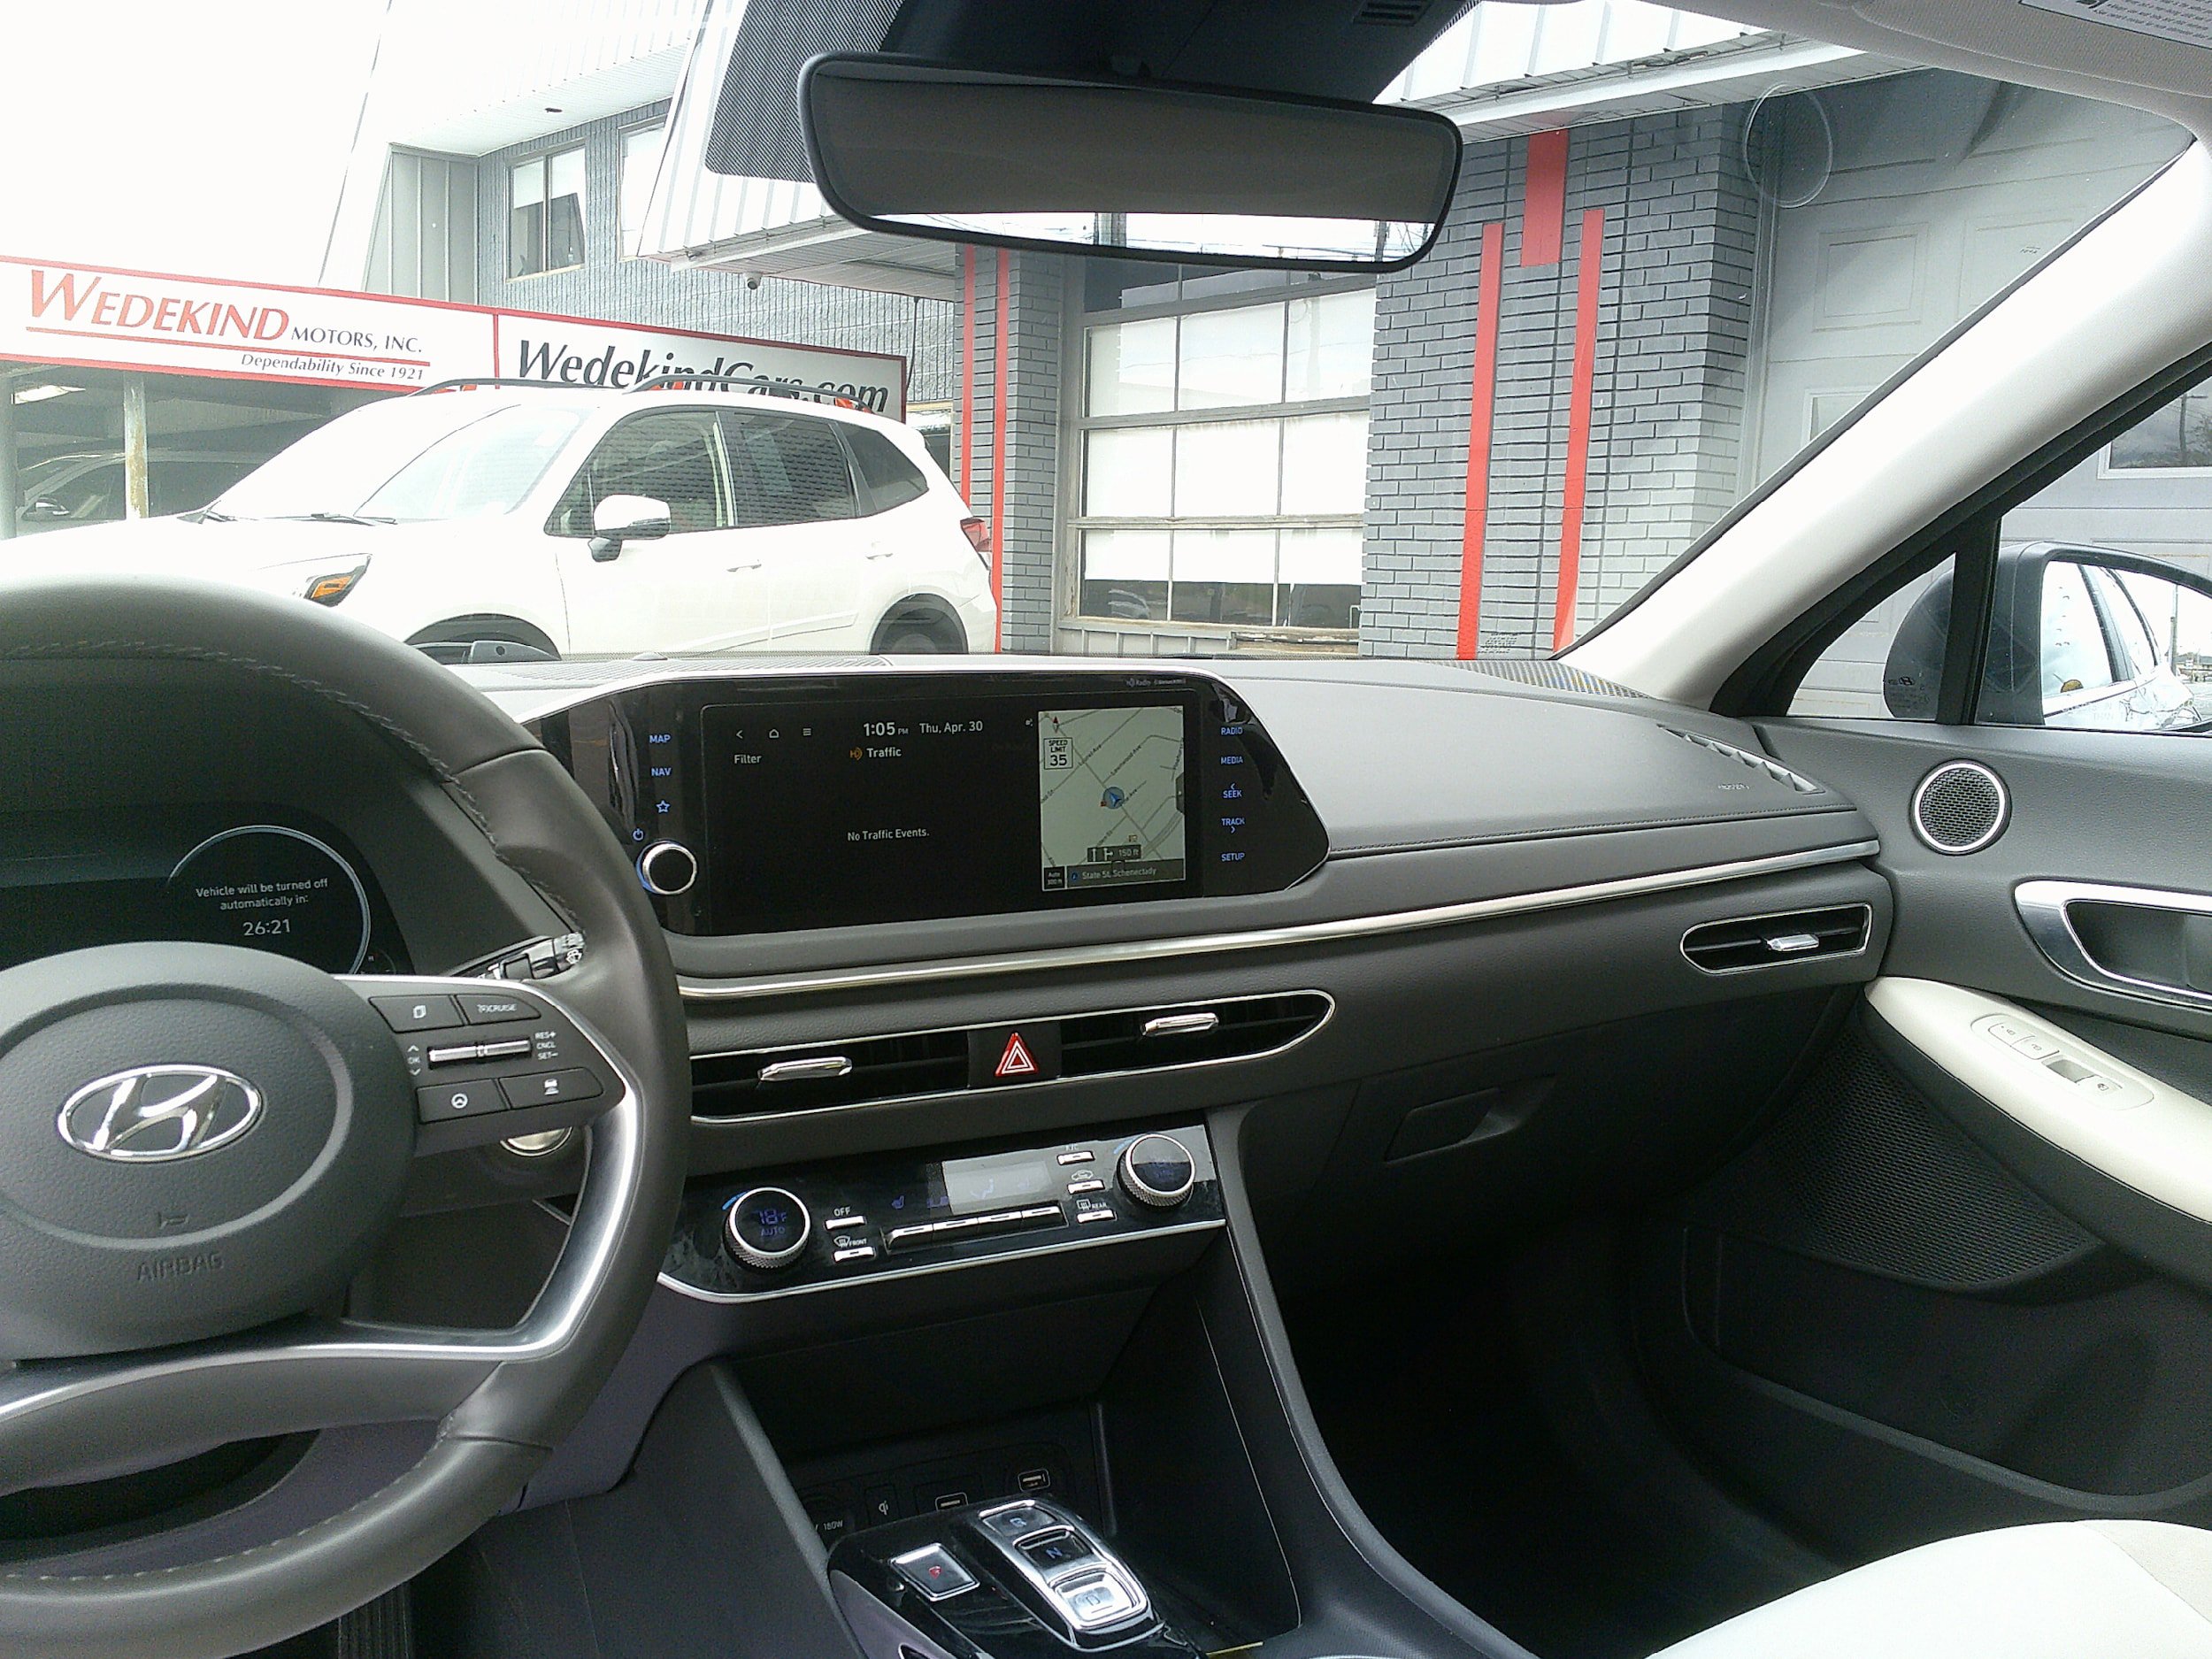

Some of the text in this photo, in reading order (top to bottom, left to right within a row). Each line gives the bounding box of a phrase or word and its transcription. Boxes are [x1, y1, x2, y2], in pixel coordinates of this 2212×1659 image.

[31, 270, 422, 353] WEDEKIND MOTORS, INC.
[242, 353, 424, 381] Dependability Since 1921
[863, 722, 895, 737] 1:05
[919, 723, 942, 735] Thu,
[944, 722, 966, 735] Apr.
[969, 720, 983, 733] 30
[1220, 727, 1243, 736] RADIO
[649, 734, 672, 744] MAP
[733, 753, 762, 764] Filter
[866, 747, 902, 759] Traffic
[1049, 755, 1068, 766] 35
[1220, 756, 1243, 765] MEDIA
[650, 767, 672, 777] NAV
[1223, 789, 1242, 798] SEEK
[1221, 817, 1245, 826] TRACK
[848, 827, 930, 841] No Traffic Events.
[1221, 852, 1245, 862] SETUP
[1082, 871, 1102, 880] State
[196, 878, 328, 897] Vehicle will be turned off
[219, 895, 309, 910] automatically in:
[242, 918, 291, 936] 26:21
[833, 1206, 851, 1217] OFF
